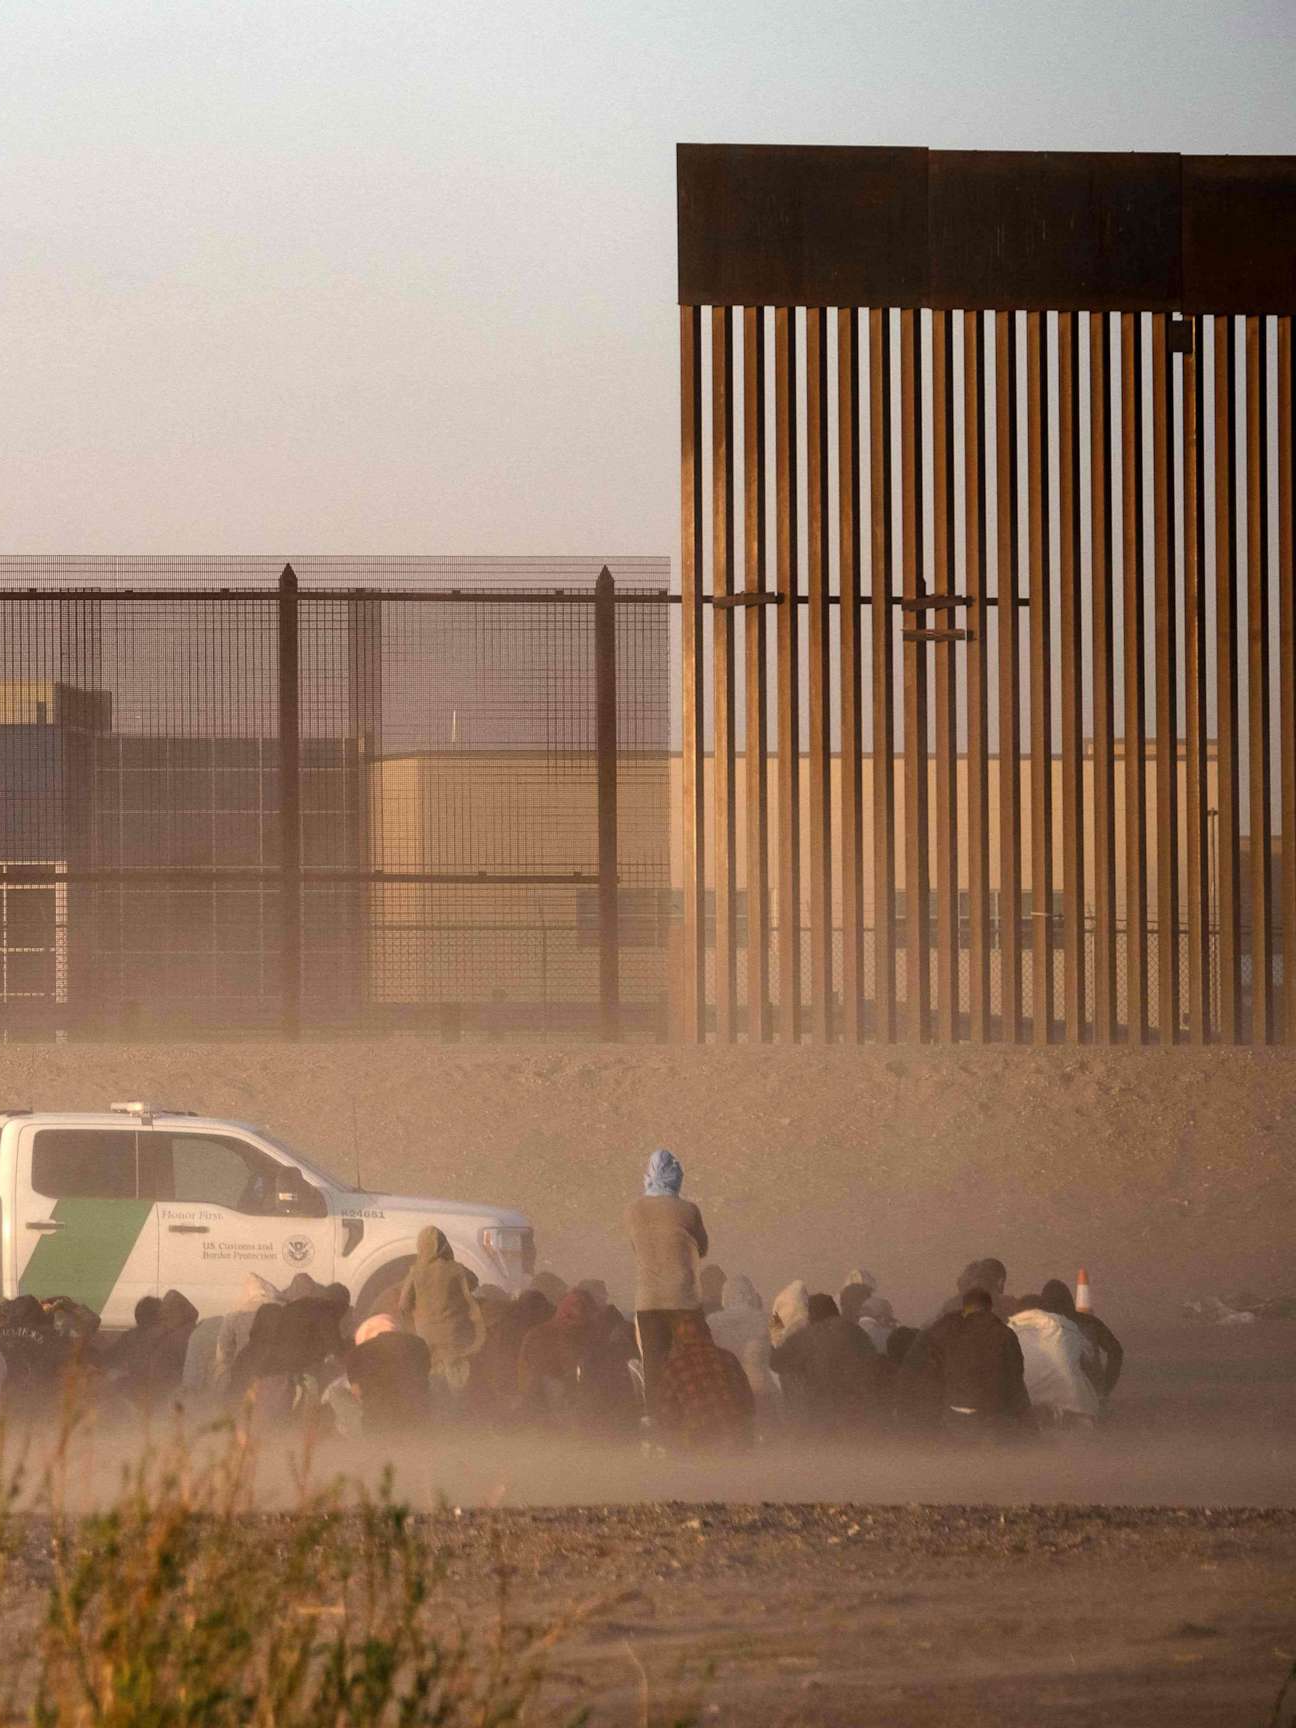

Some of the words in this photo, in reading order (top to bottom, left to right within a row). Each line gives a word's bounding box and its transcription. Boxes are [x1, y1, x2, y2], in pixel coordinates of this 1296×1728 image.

[161, 1210, 196, 1220] Honor
[218, 1241, 255, 1251] Customs
[257, 1241, 273, 1251] and
[202, 1251, 231, 1261] Border
[232, 1251, 278, 1262] Protection
